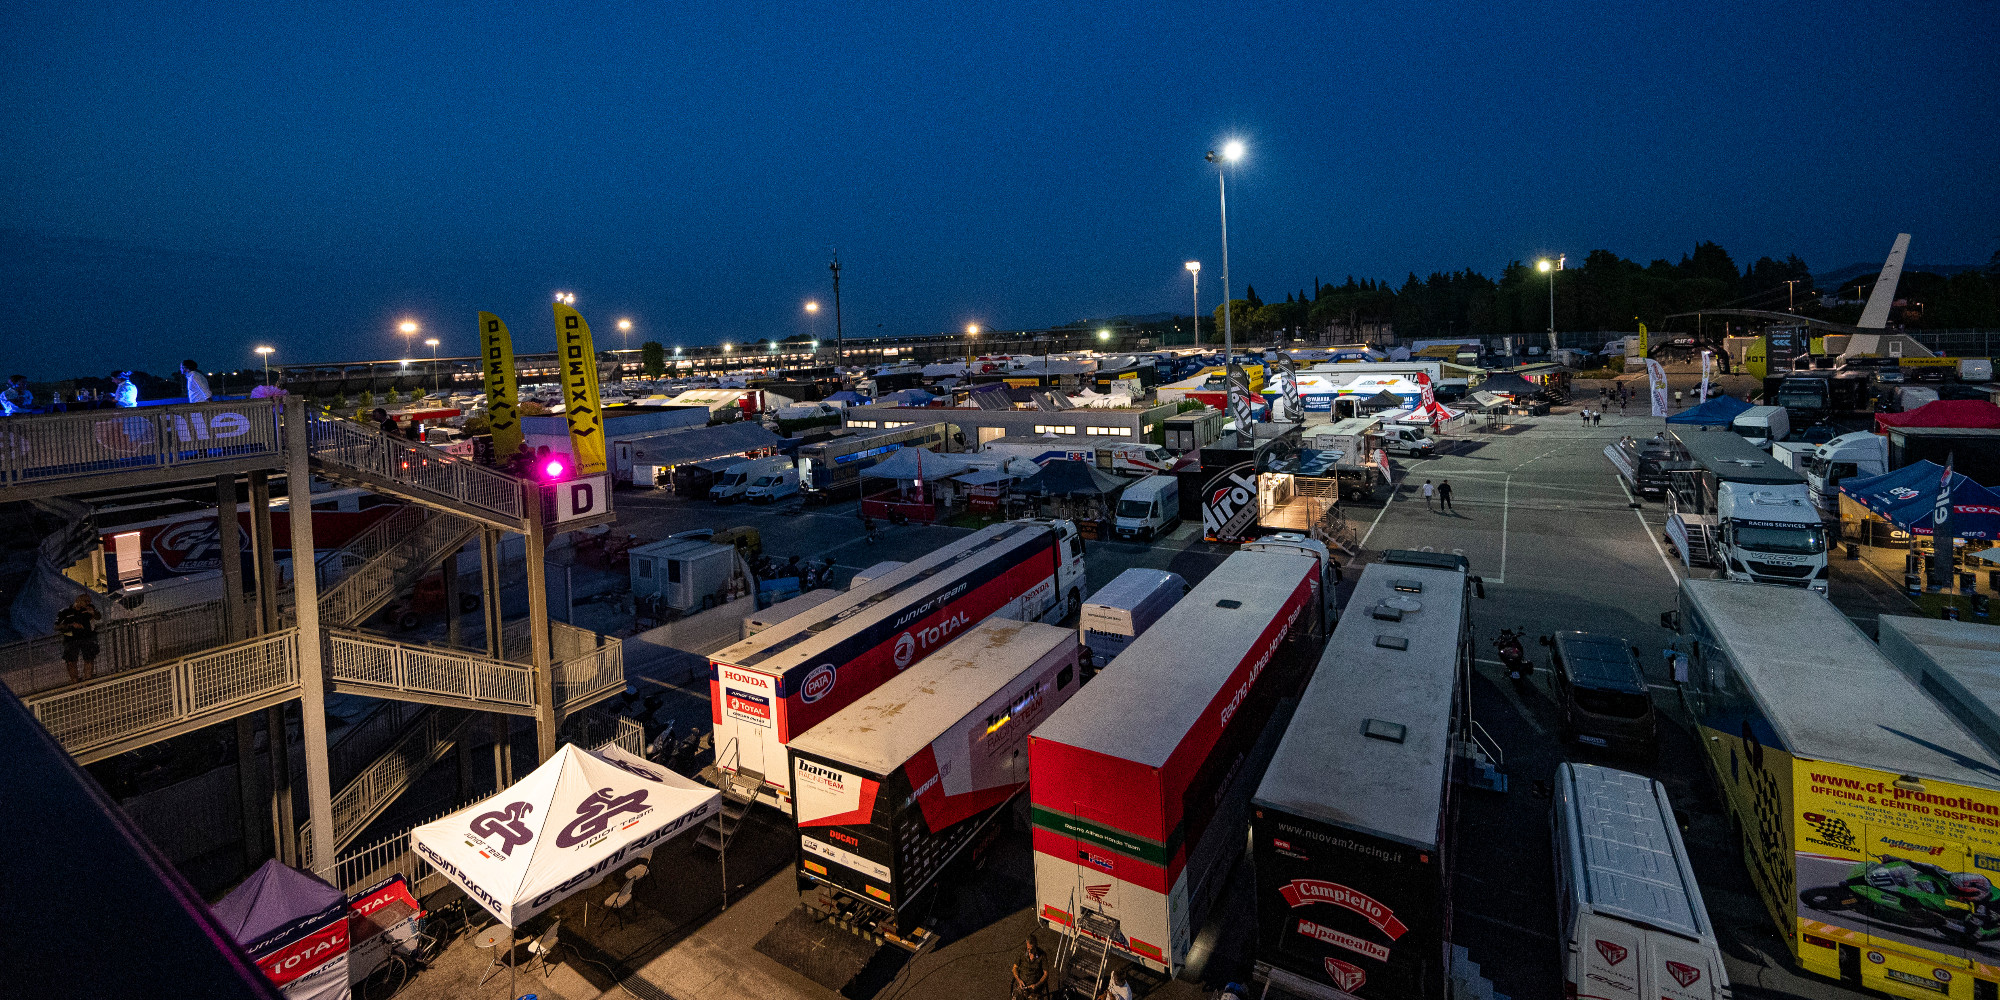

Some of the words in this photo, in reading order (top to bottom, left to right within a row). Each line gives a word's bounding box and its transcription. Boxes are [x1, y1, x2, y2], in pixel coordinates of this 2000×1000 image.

[488, 319, 506, 400] XLMOTO
[565, 315, 588, 402] XLMOTO
[571, 483, 593, 515] D
[916, 610, 970, 649] TOTAL
[725, 671, 769, 689] HONDA
[808, 673, 829, 694] PATA
[739, 702, 765, 716] TOTAL
[1811, 785, 1865, 804] OFFICINA
[1881, 798, 1930, 815] CENTRO
[829, 829, 858, 847] DUCATI
[1065, 823, 1084, 834] Racing
[1278, 822, 1402, 863] www.nuovam2racing.it
[1805, 837, 1861, 854] PROMOTION
[348, 893, 394, 919] OTAL
[1300, 882, 1382, 918] Campiello
[270, 935, 345, 974] TOTAL
